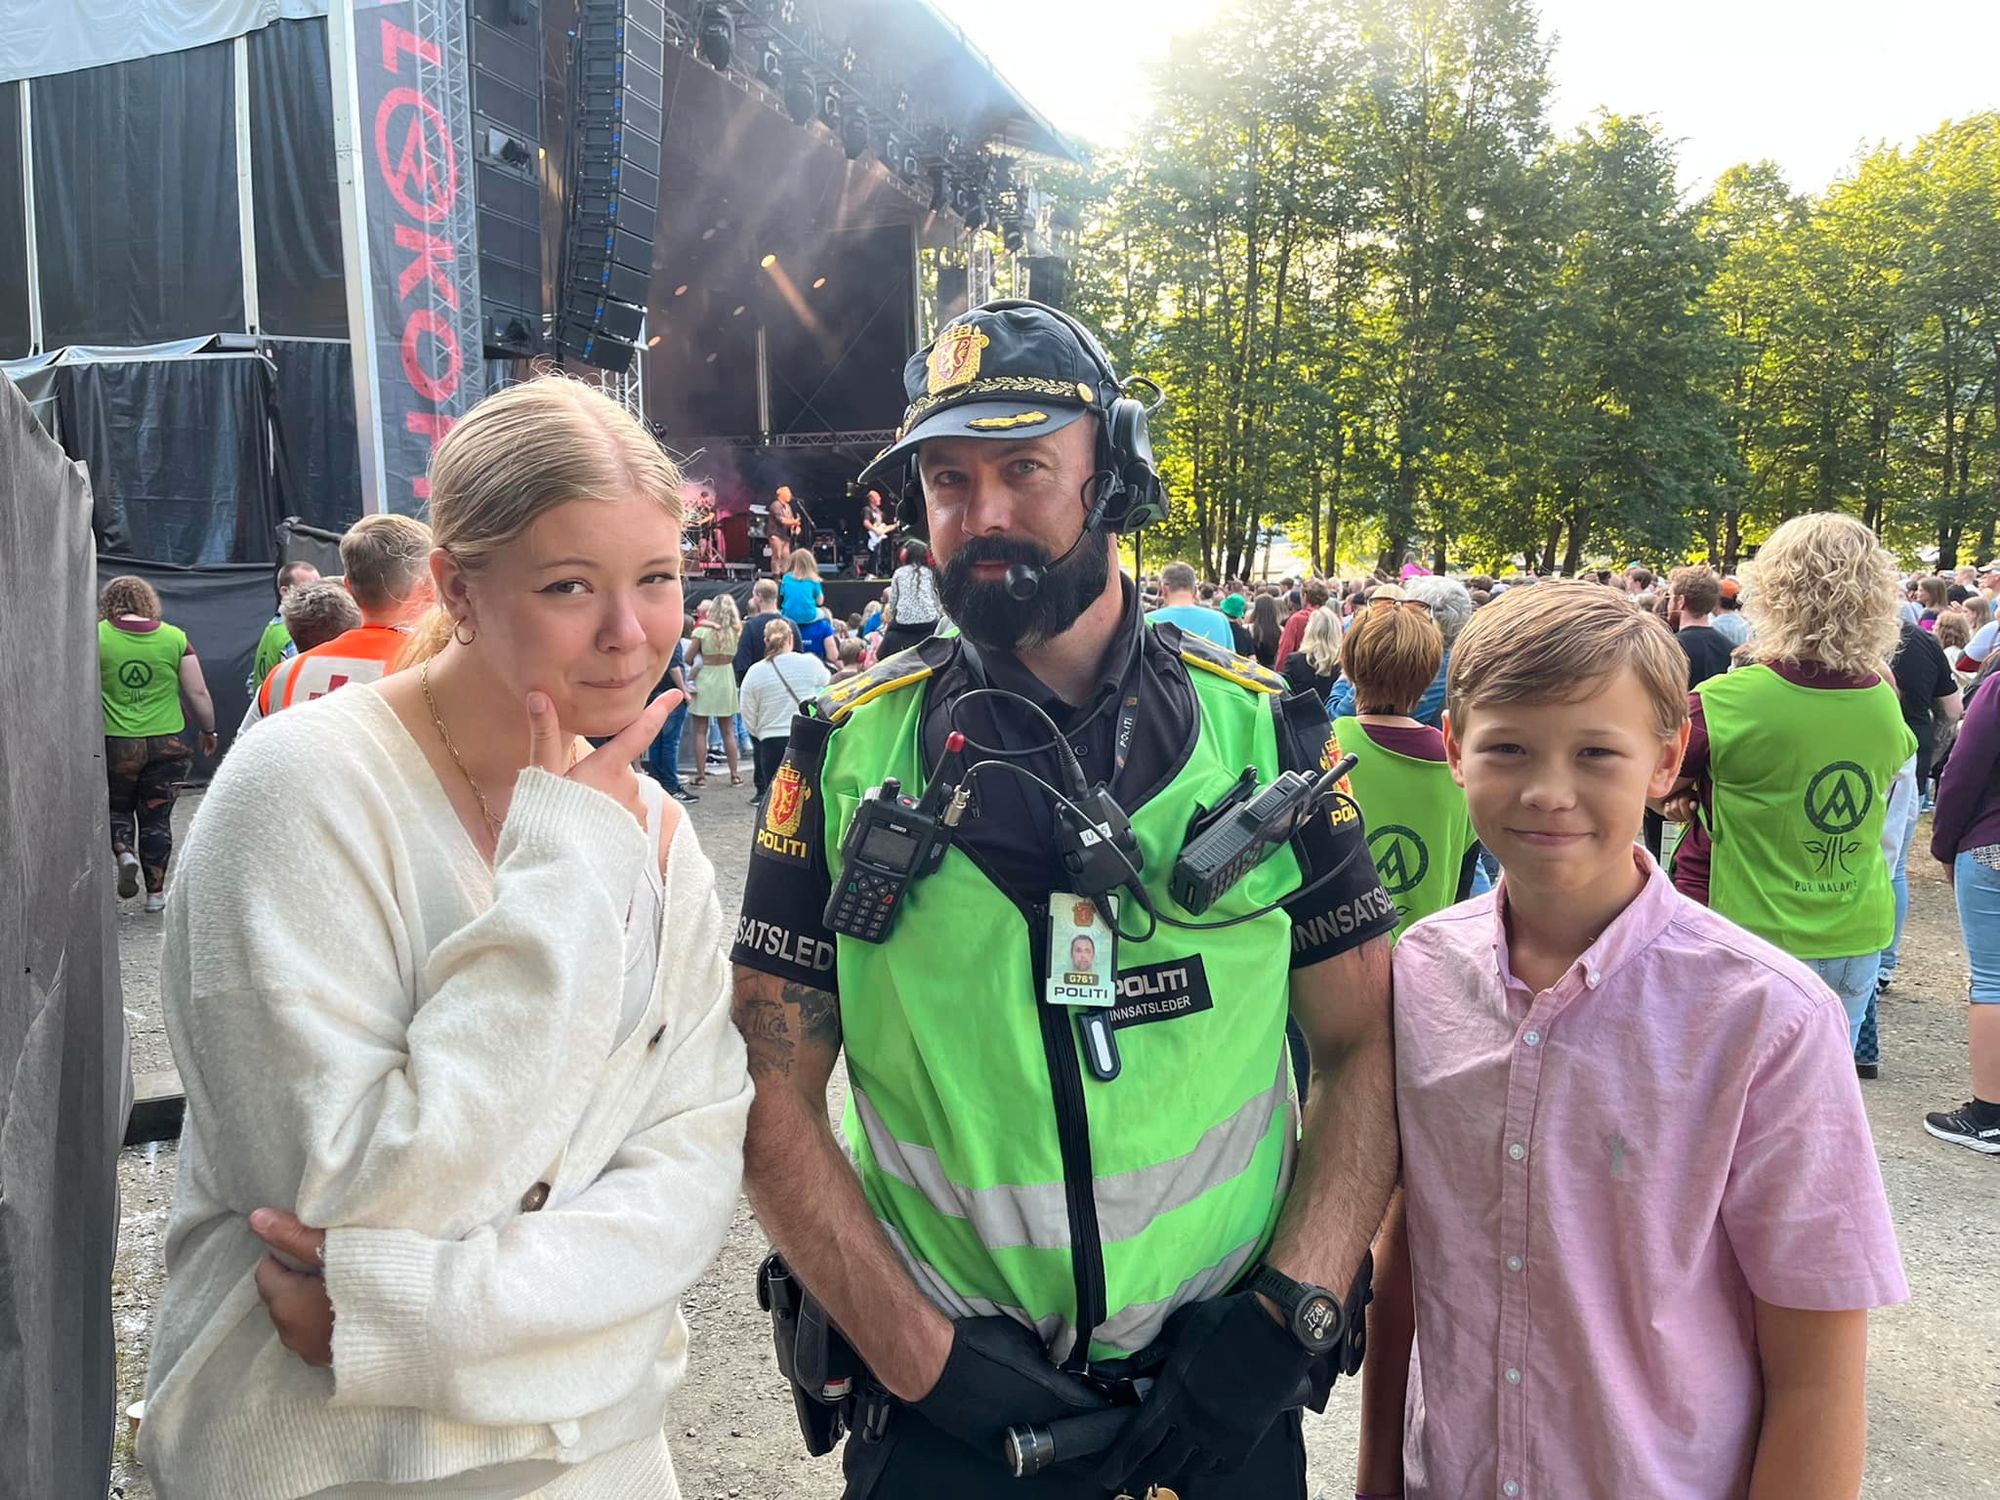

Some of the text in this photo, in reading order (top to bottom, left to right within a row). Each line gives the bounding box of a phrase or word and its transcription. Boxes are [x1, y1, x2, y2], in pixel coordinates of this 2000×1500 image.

[1119, 717, 1133, 748] POLITI
[757, 828, 807, 858] POLITI
[1054, 987, 1108, 999] POLITI
[1109, 995, 1191, 1022] INNSATSLEDER
